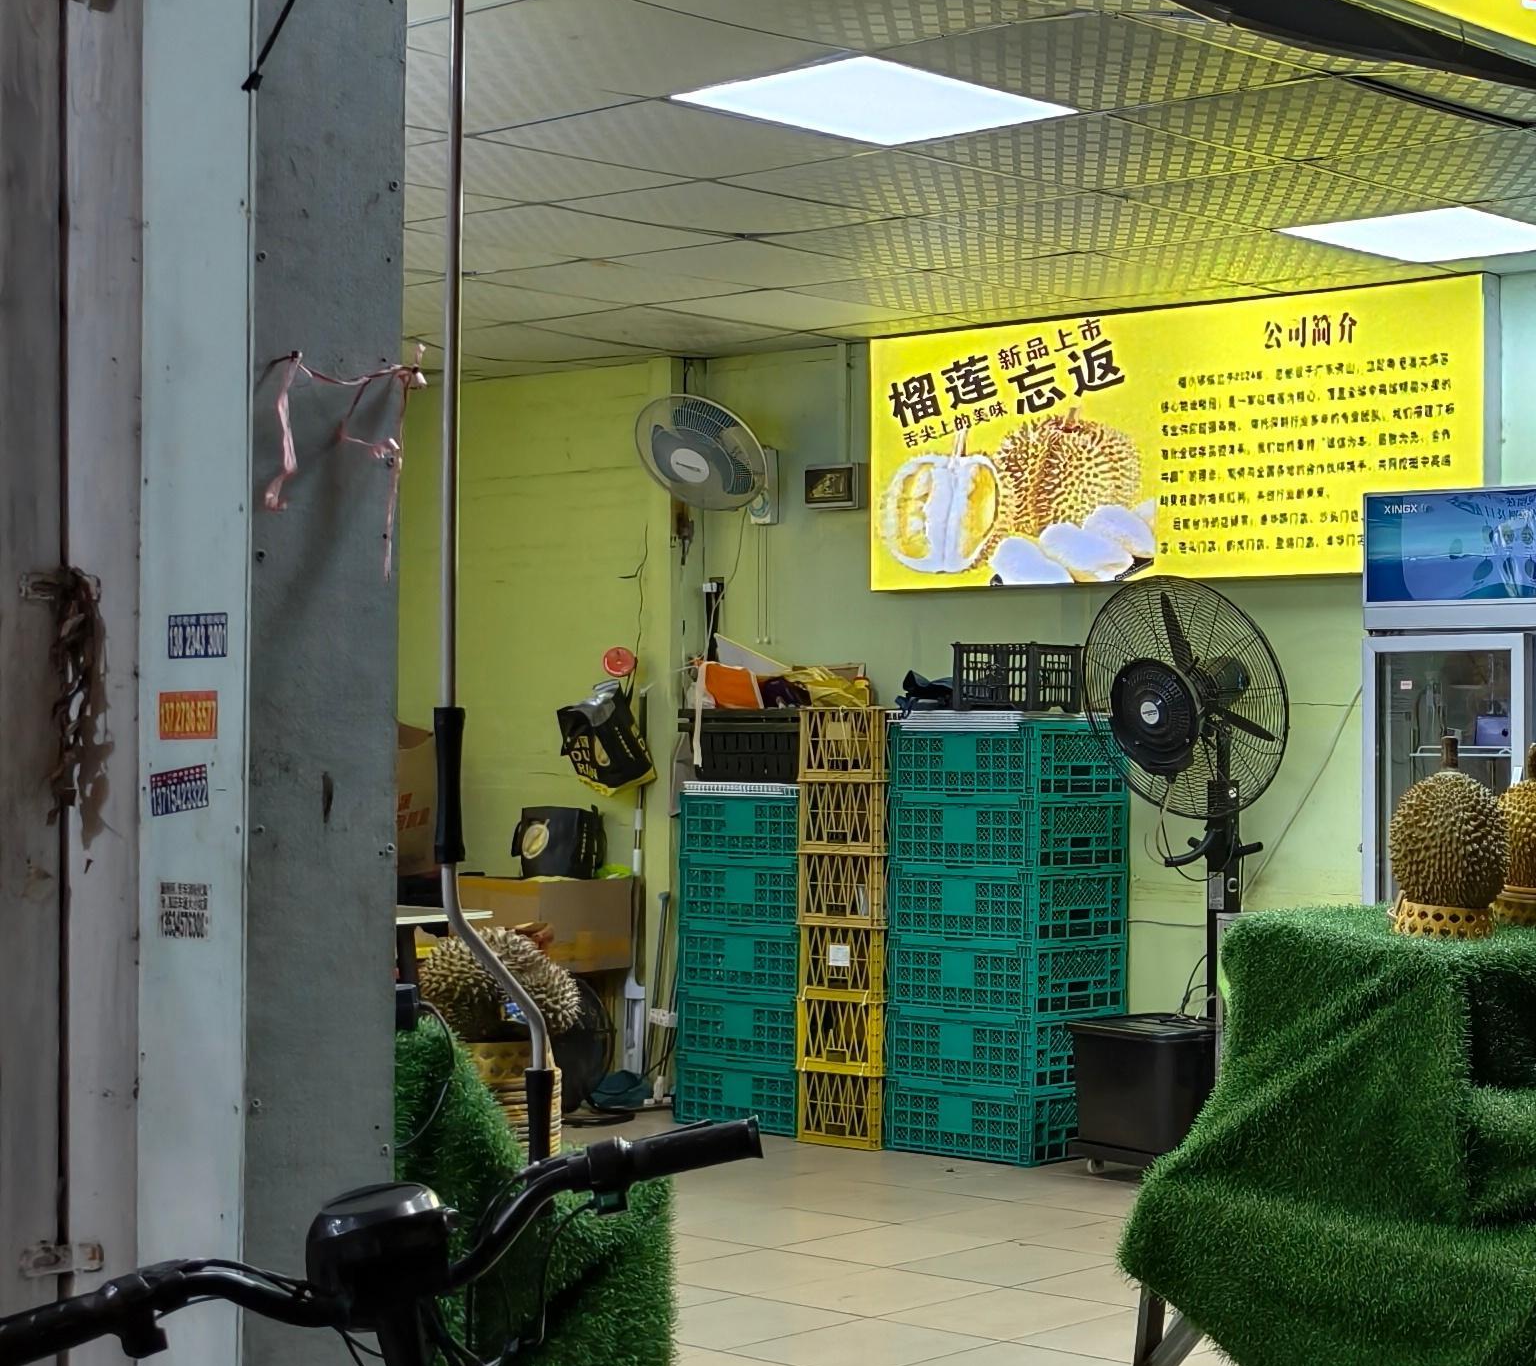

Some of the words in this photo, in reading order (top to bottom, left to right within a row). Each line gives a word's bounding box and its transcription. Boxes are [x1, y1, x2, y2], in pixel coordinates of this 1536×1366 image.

[998, 318, 1102, 371] 新品上市
[1263, 311, 1357, 349] 公司简介
[889, 339, 1126, 428] 榴莲忘返
[903, 401, 1008, 448] 舌尖上的美味
